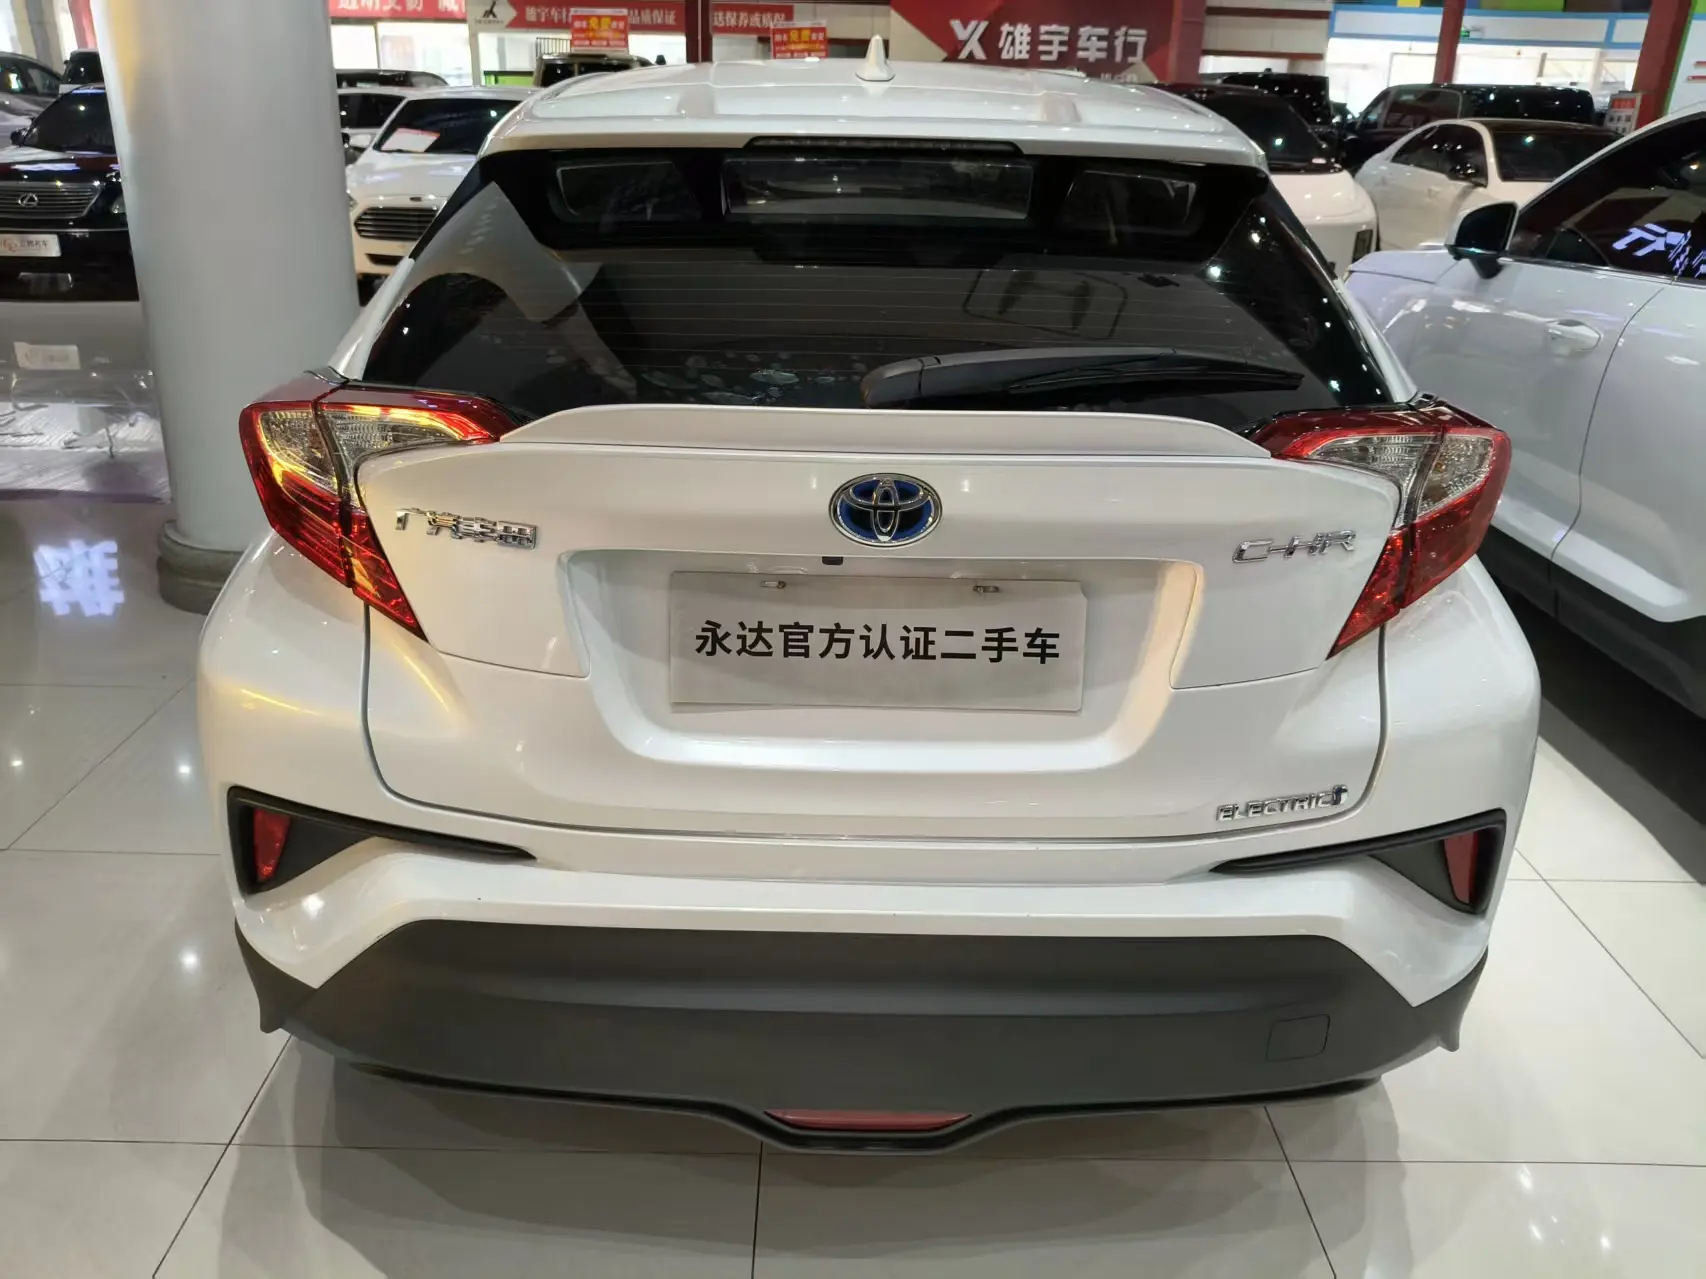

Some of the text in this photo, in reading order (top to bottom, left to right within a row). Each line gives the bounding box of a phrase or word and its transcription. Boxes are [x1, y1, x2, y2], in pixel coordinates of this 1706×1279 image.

[997, 22, 1148, 64] 雄宇车行
[1231, 529, 1357, 564] C-HR
[694, 620, 1061, 665] 永达官方认证二手车
[1215, 791, 1333, 822] ELECTRIC
